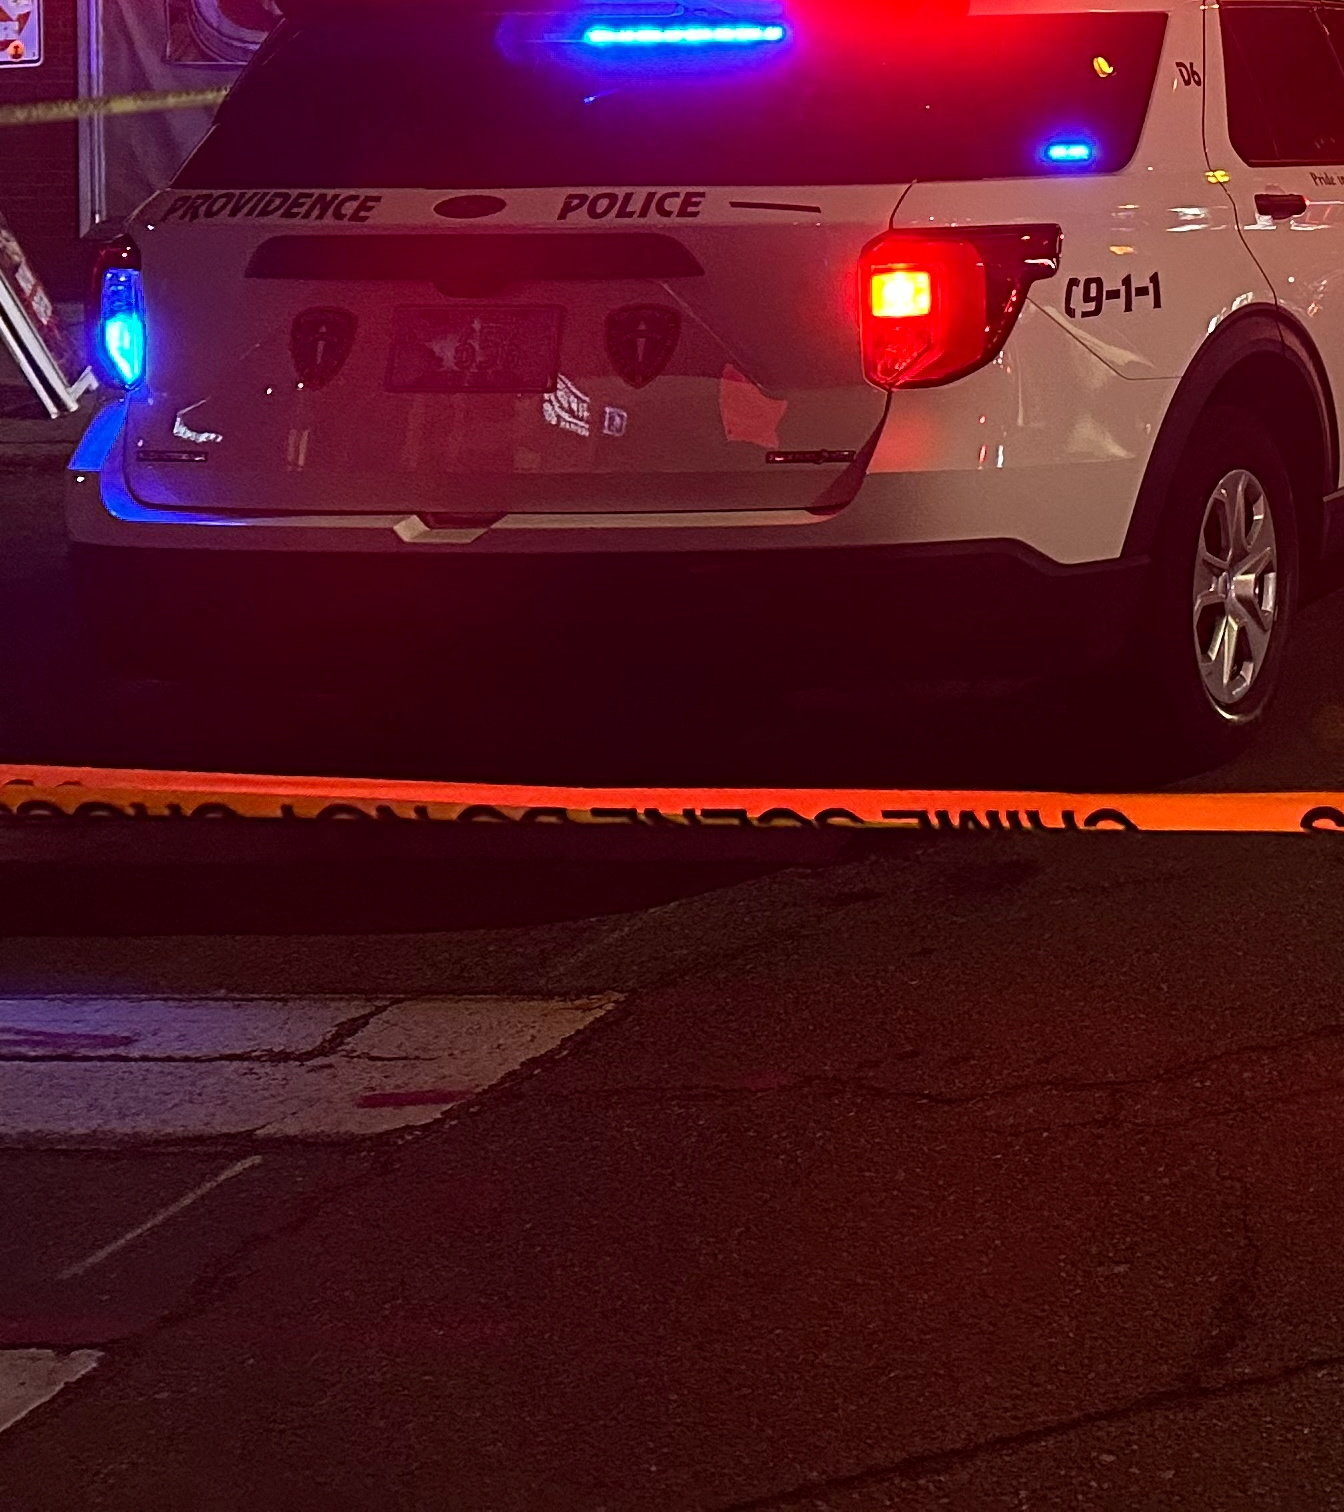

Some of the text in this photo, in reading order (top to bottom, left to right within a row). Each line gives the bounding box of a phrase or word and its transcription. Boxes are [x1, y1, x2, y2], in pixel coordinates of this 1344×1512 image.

[1176, 62, 1202, 87] D6
[1309, 171, 1336, 186] Pride
[161, 190, 706, 223] PROVIDENCE POLICE
[1064, 272, 1162, 319] C9-1-1
